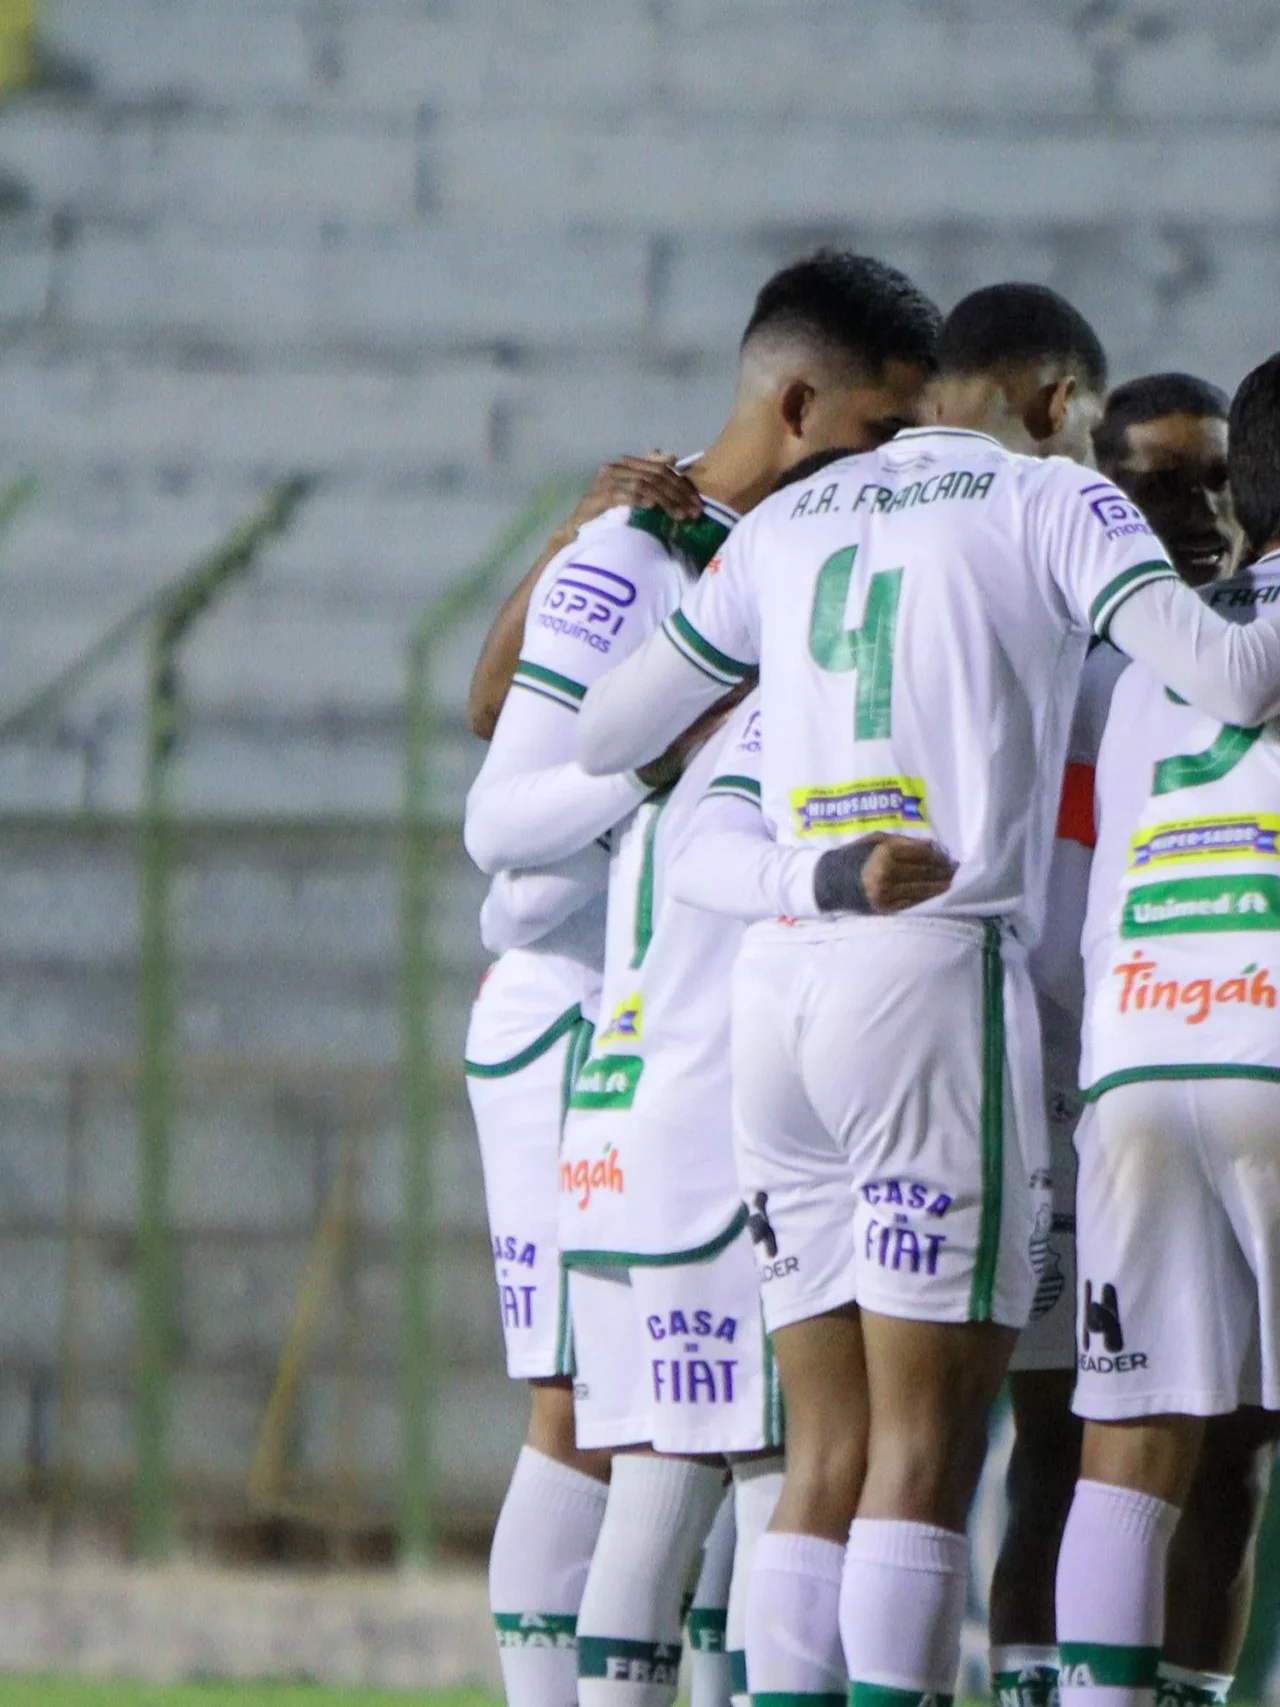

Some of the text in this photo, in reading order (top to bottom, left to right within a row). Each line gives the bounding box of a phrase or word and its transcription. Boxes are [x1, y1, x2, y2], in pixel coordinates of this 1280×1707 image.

[852, 471, 996, 515] FRANCANA
[808, 544, 904, 743] 4
[861, 1179, 952, 1218] CASA
[866, 1219, 946, 1275] FIAT
[647, 1310, 738, 1344] CASA
[652, 1360, 738, 1404] FIAT
